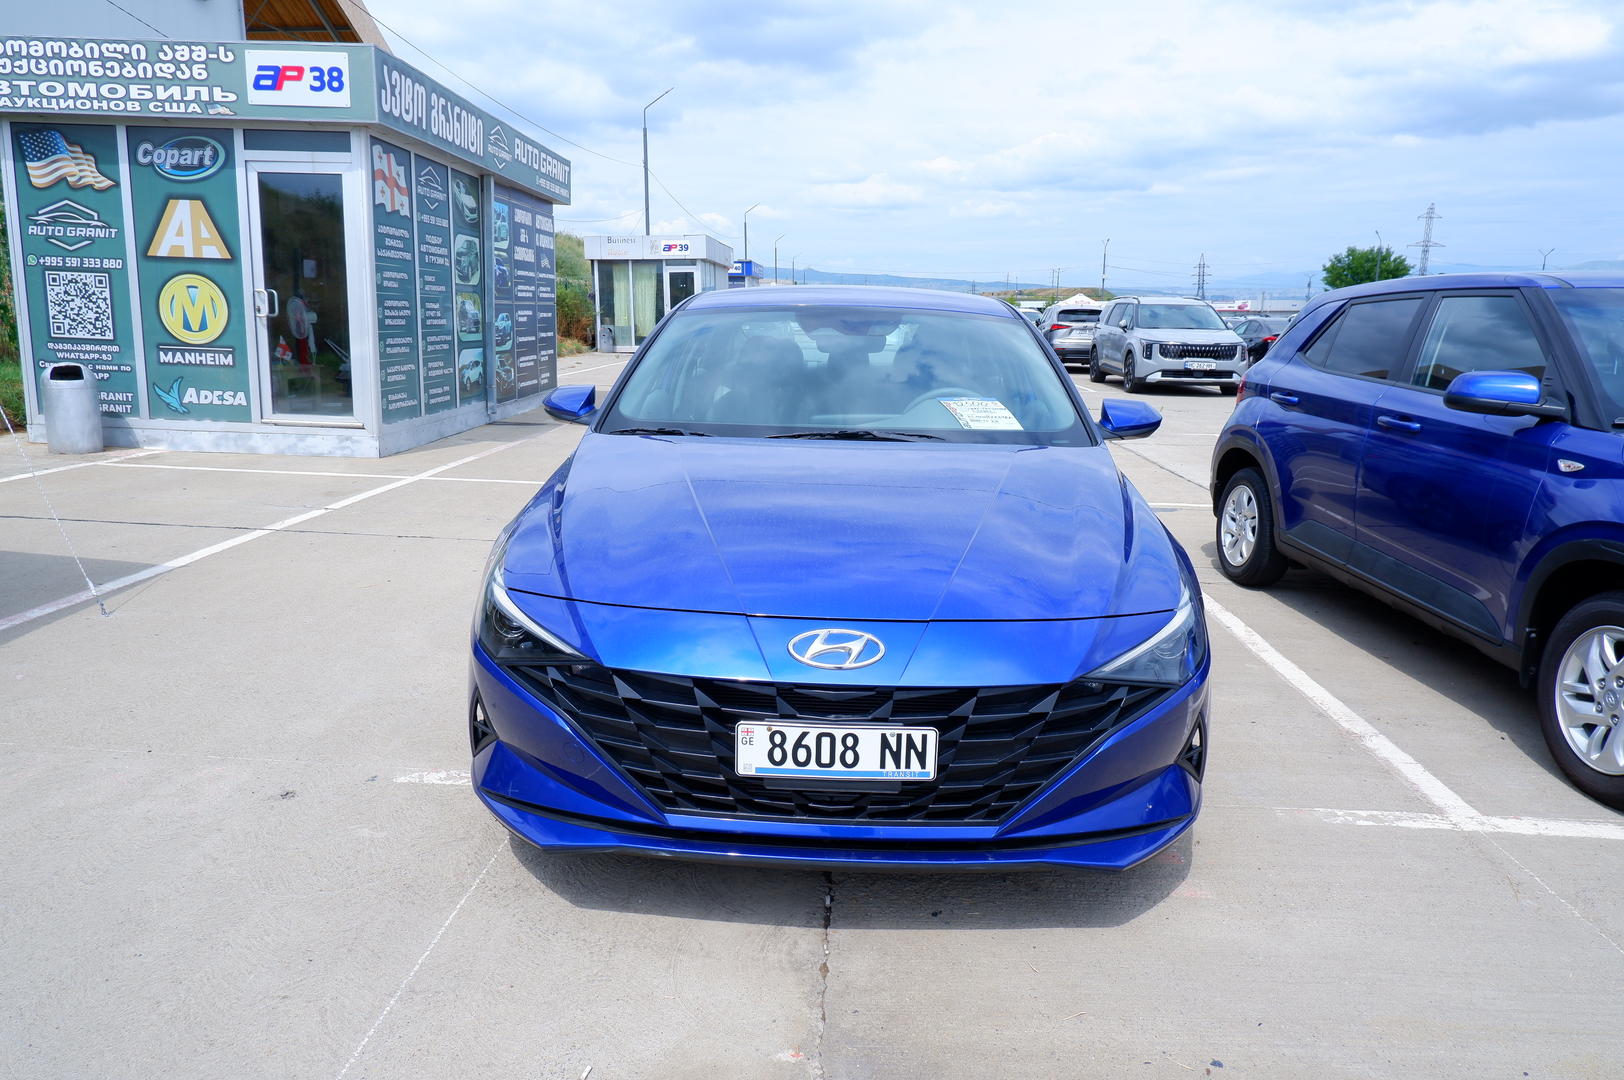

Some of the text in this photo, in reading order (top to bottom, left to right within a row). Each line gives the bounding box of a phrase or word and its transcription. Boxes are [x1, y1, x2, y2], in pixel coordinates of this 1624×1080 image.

[0, 39, 235, 62] ომობილი აშშ-ს
[309, 66, 345, 93] 38
[0, 96, 203, 113] АУКЦИОНОВ США
[381, 65, 484, 157] ავტო გრანიტი
[137, 143, 214, 169] Copart
[514, 138, 570, 185] AUTO GRANIT
[28, 225, 118, 238] AUTO GRANIT
[678, 243, 689, 252] 39
[39, 256, 123, 268] +995 591 333 880
[159, 351, 233, 366] MANHEIM
[99, 392, 134, 402] RANIT
[182, 387, 247, 406] ADESA
[740, 736, 755, 746] GE
[767, 729, 929, 770] 8608 NN
[882, 770, 920, 778] TRANSIT
